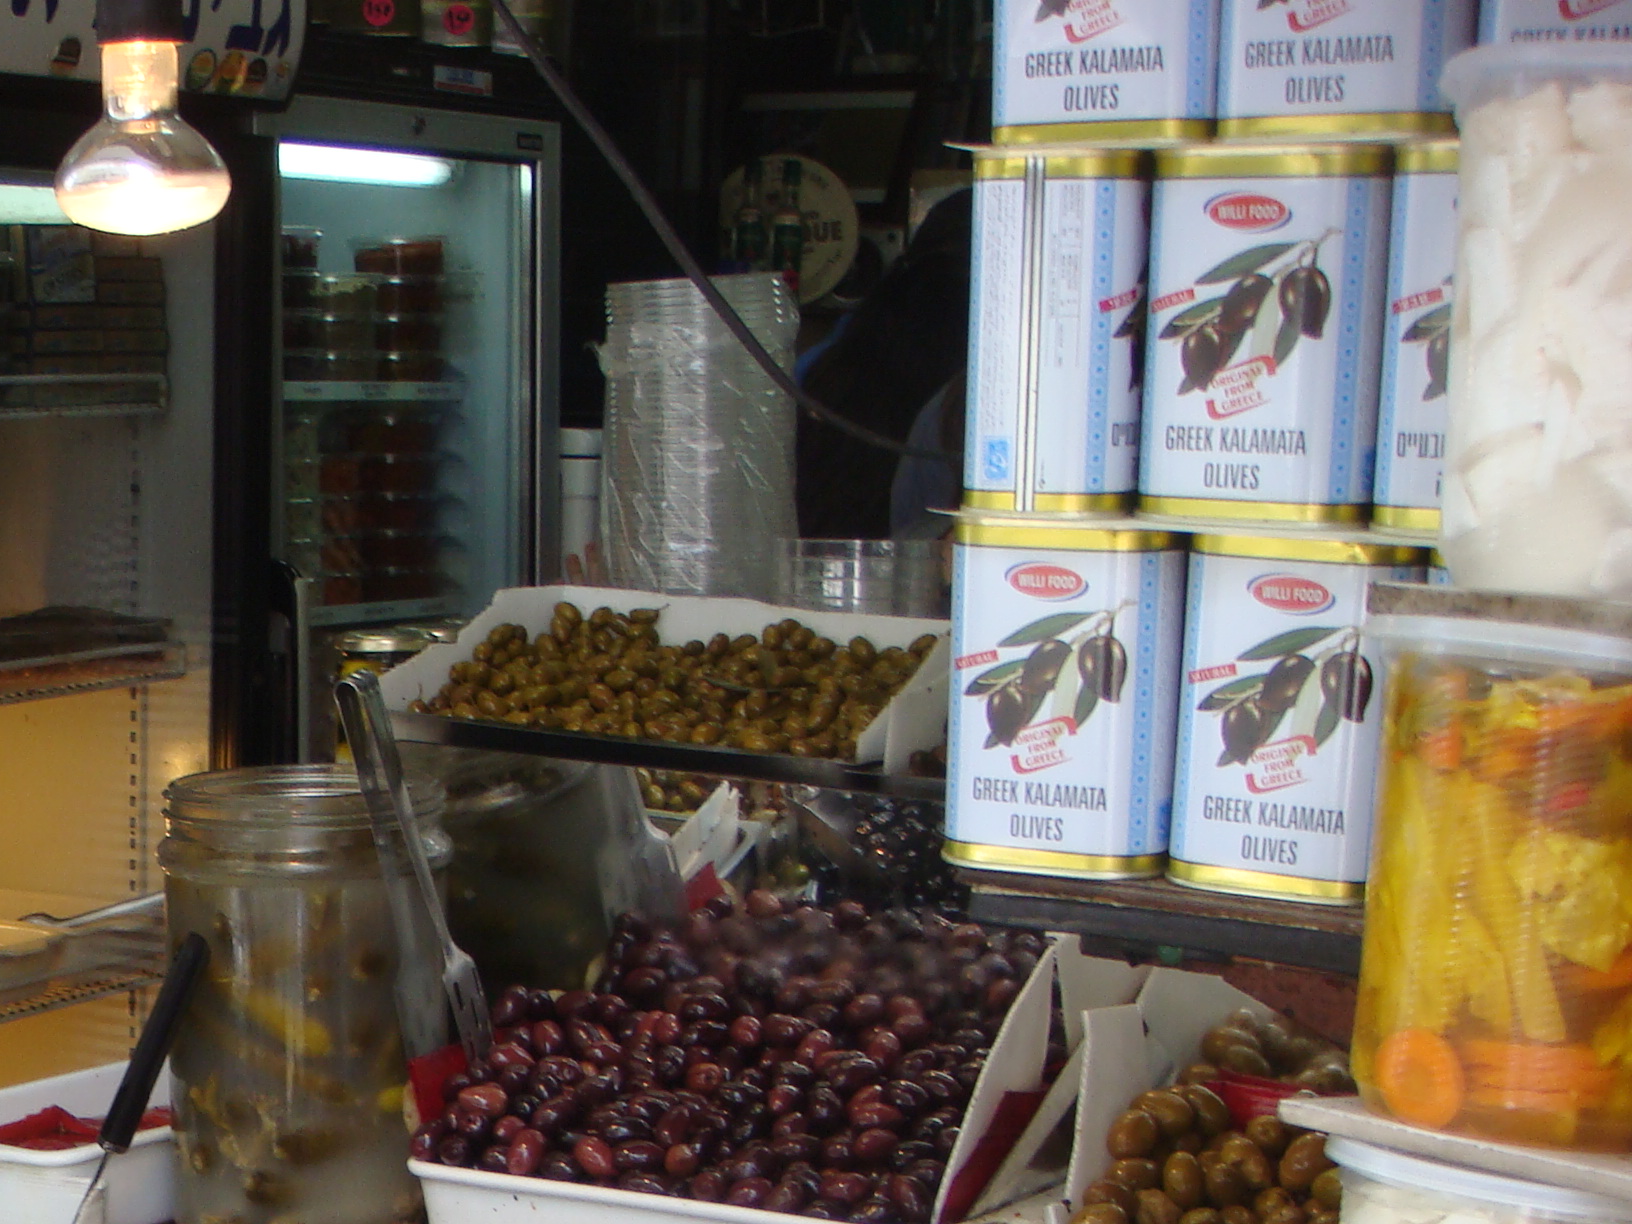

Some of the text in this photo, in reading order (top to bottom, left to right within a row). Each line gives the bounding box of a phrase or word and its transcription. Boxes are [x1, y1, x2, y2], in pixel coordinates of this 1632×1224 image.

[1025, 46, 1164, 78] GREEK KALAMATA
[1245, 35, 1394, 69] GREEK KALAMATA
[1063, 84, 1119, 111] OLIVES
[1285, 75, 1345, 103] OLIVES
[1217, 205, 1280, 220] WILLI FOOD
[1209, 365, 1263, 389] ORIGINAL
[1224, 381, 1255, 398] FROM
[1221, 391, 1263, 411] GREECE
[1166, 426, 1213, 451] GREEK
[1220, 429, 1306, 455] KALAMATA
[1204, 463, 1260, 490] OLIVES
[1017, 573, 1077, 589] WILLI FOOD
[1261, 585, 1323, 603] WILLI FOOD
[1015, 725, 1064, 745] ORIGINAL
[1028, 740, 1057, 754] FROM
[1250, 744, 1303, 764] ORIGINAL
[1025, 750, 1067, 767] GREECE
[1263, 759, 1295, 774] FROM
[1260, 770, 1304, 787] GREECE
[973, 777, 1107, 811] GREEK KALAMATA
[1203, 795, 1345, 835] GREEK KALAMATA
[1010, 814, 1064, 841] OLIVES
[1241, 835, 1298, 865] OLIVES
